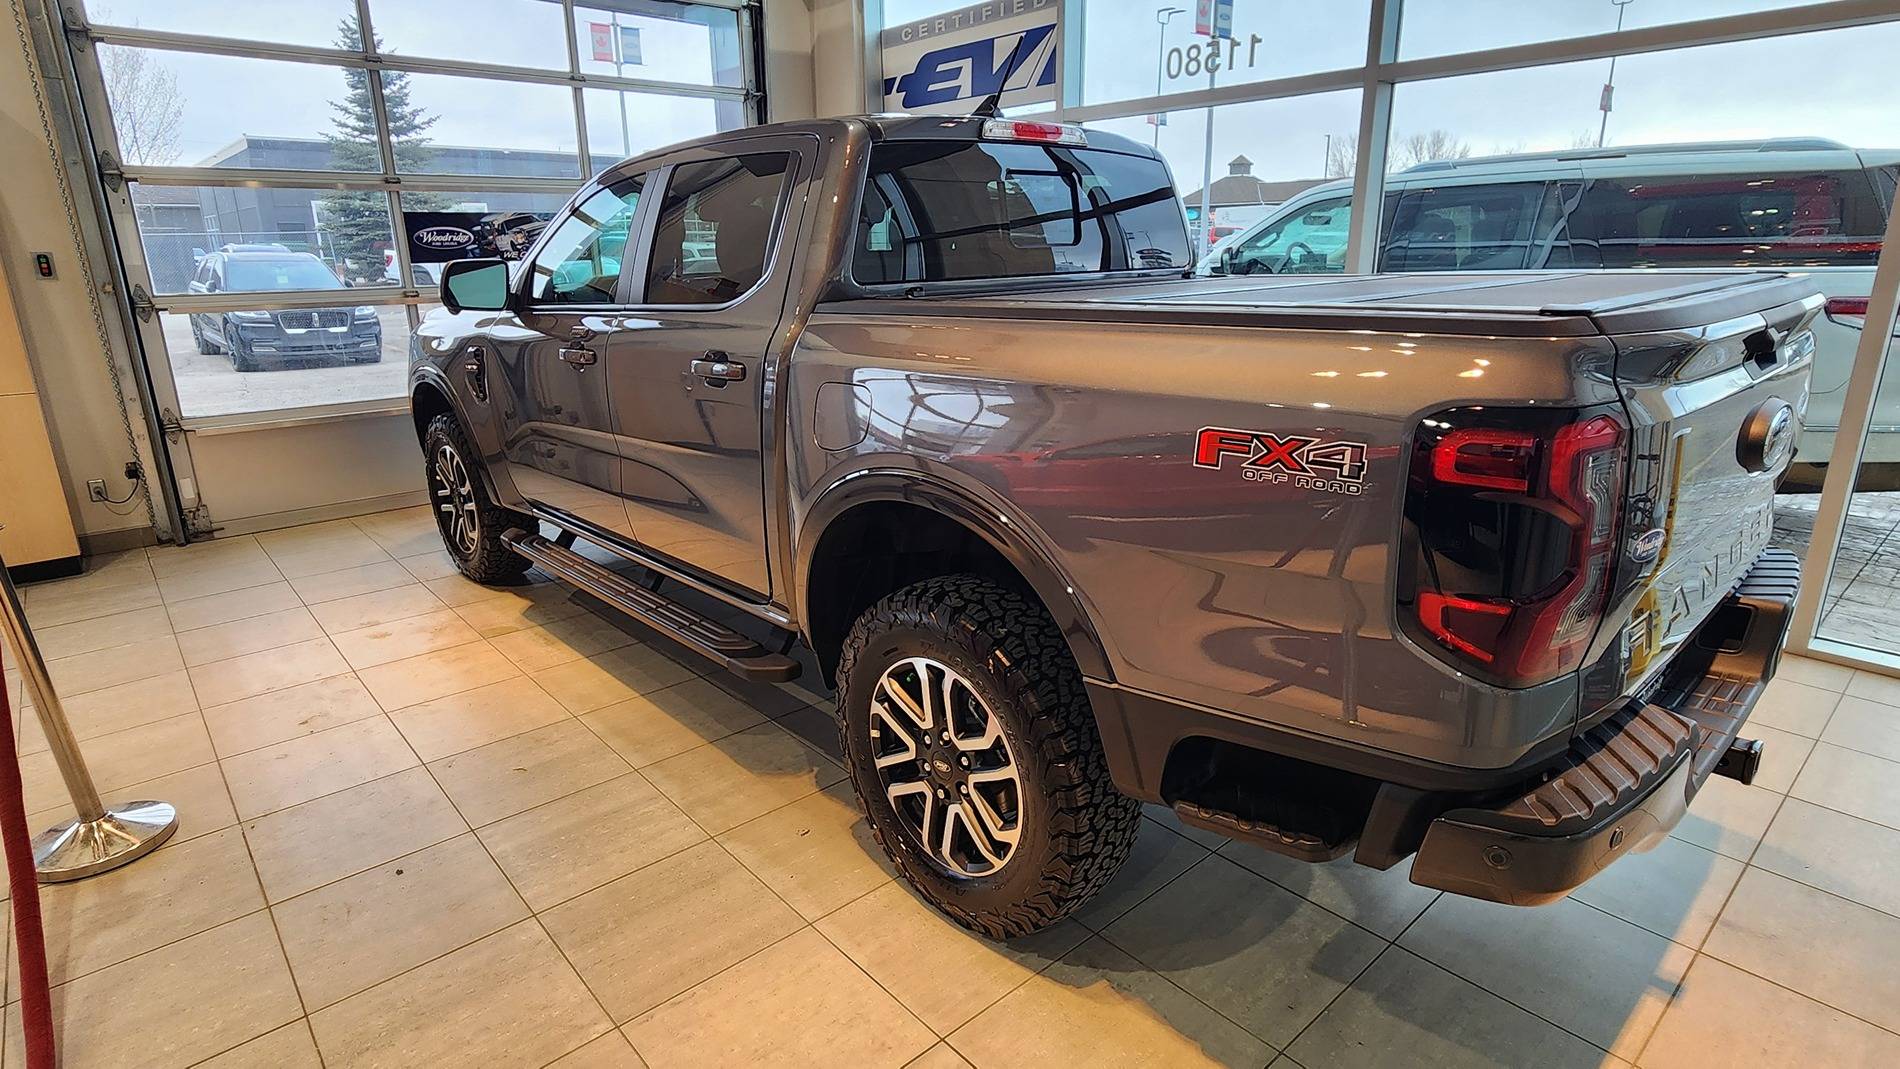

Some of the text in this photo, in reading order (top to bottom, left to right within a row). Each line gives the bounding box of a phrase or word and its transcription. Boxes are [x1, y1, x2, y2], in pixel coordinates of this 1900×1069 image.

[901, 0, 1047, 41] CERTIFIED
[420, 231, 469, 243] Woodridge
[1193, 426, 1368, 482] FX4
[1242, 469, 1362, 495] OFF ROAD
